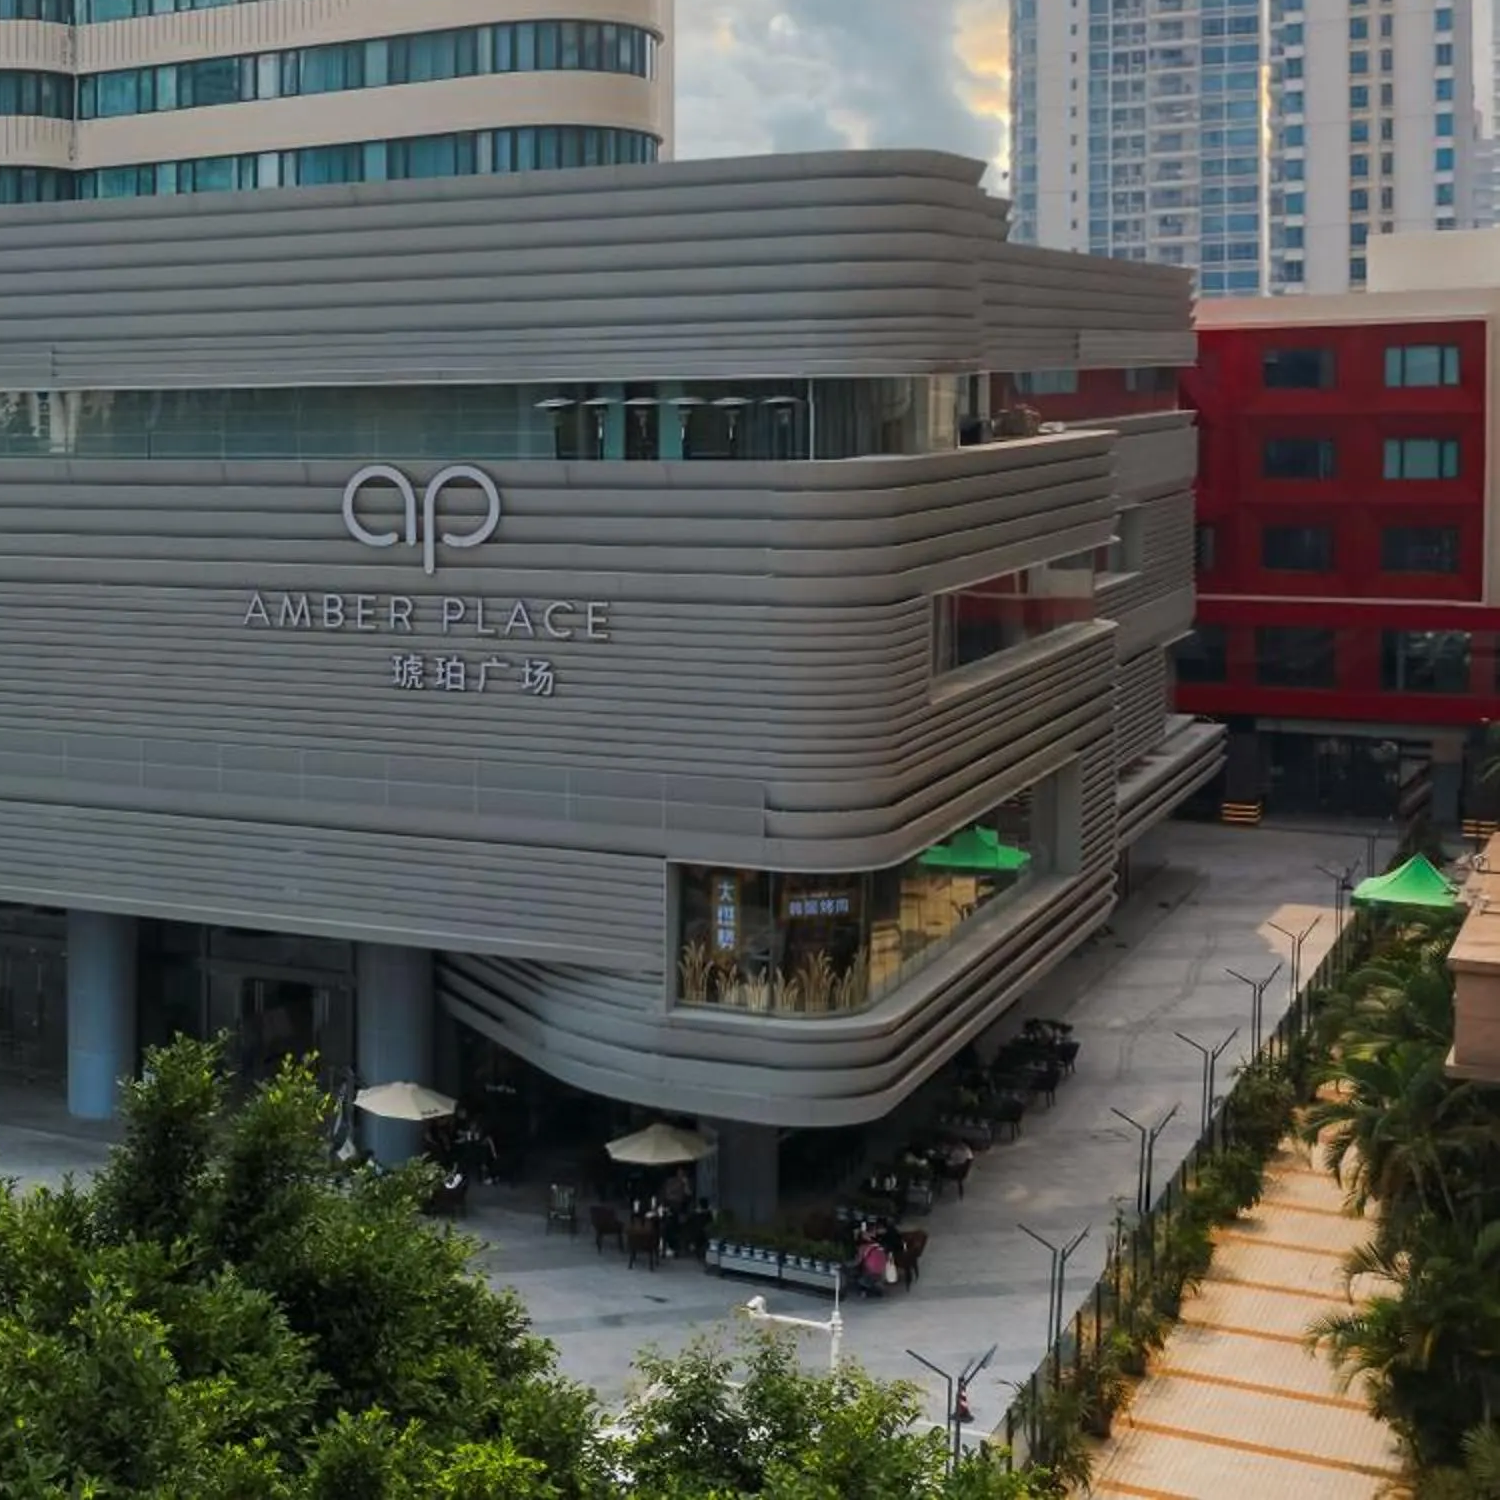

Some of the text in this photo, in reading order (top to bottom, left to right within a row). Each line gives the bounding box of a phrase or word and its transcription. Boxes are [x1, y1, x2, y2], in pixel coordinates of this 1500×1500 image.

[243, 591, 611, 640] AMBER PLACE
[392, 653, 556, 697] 琥珀广场
